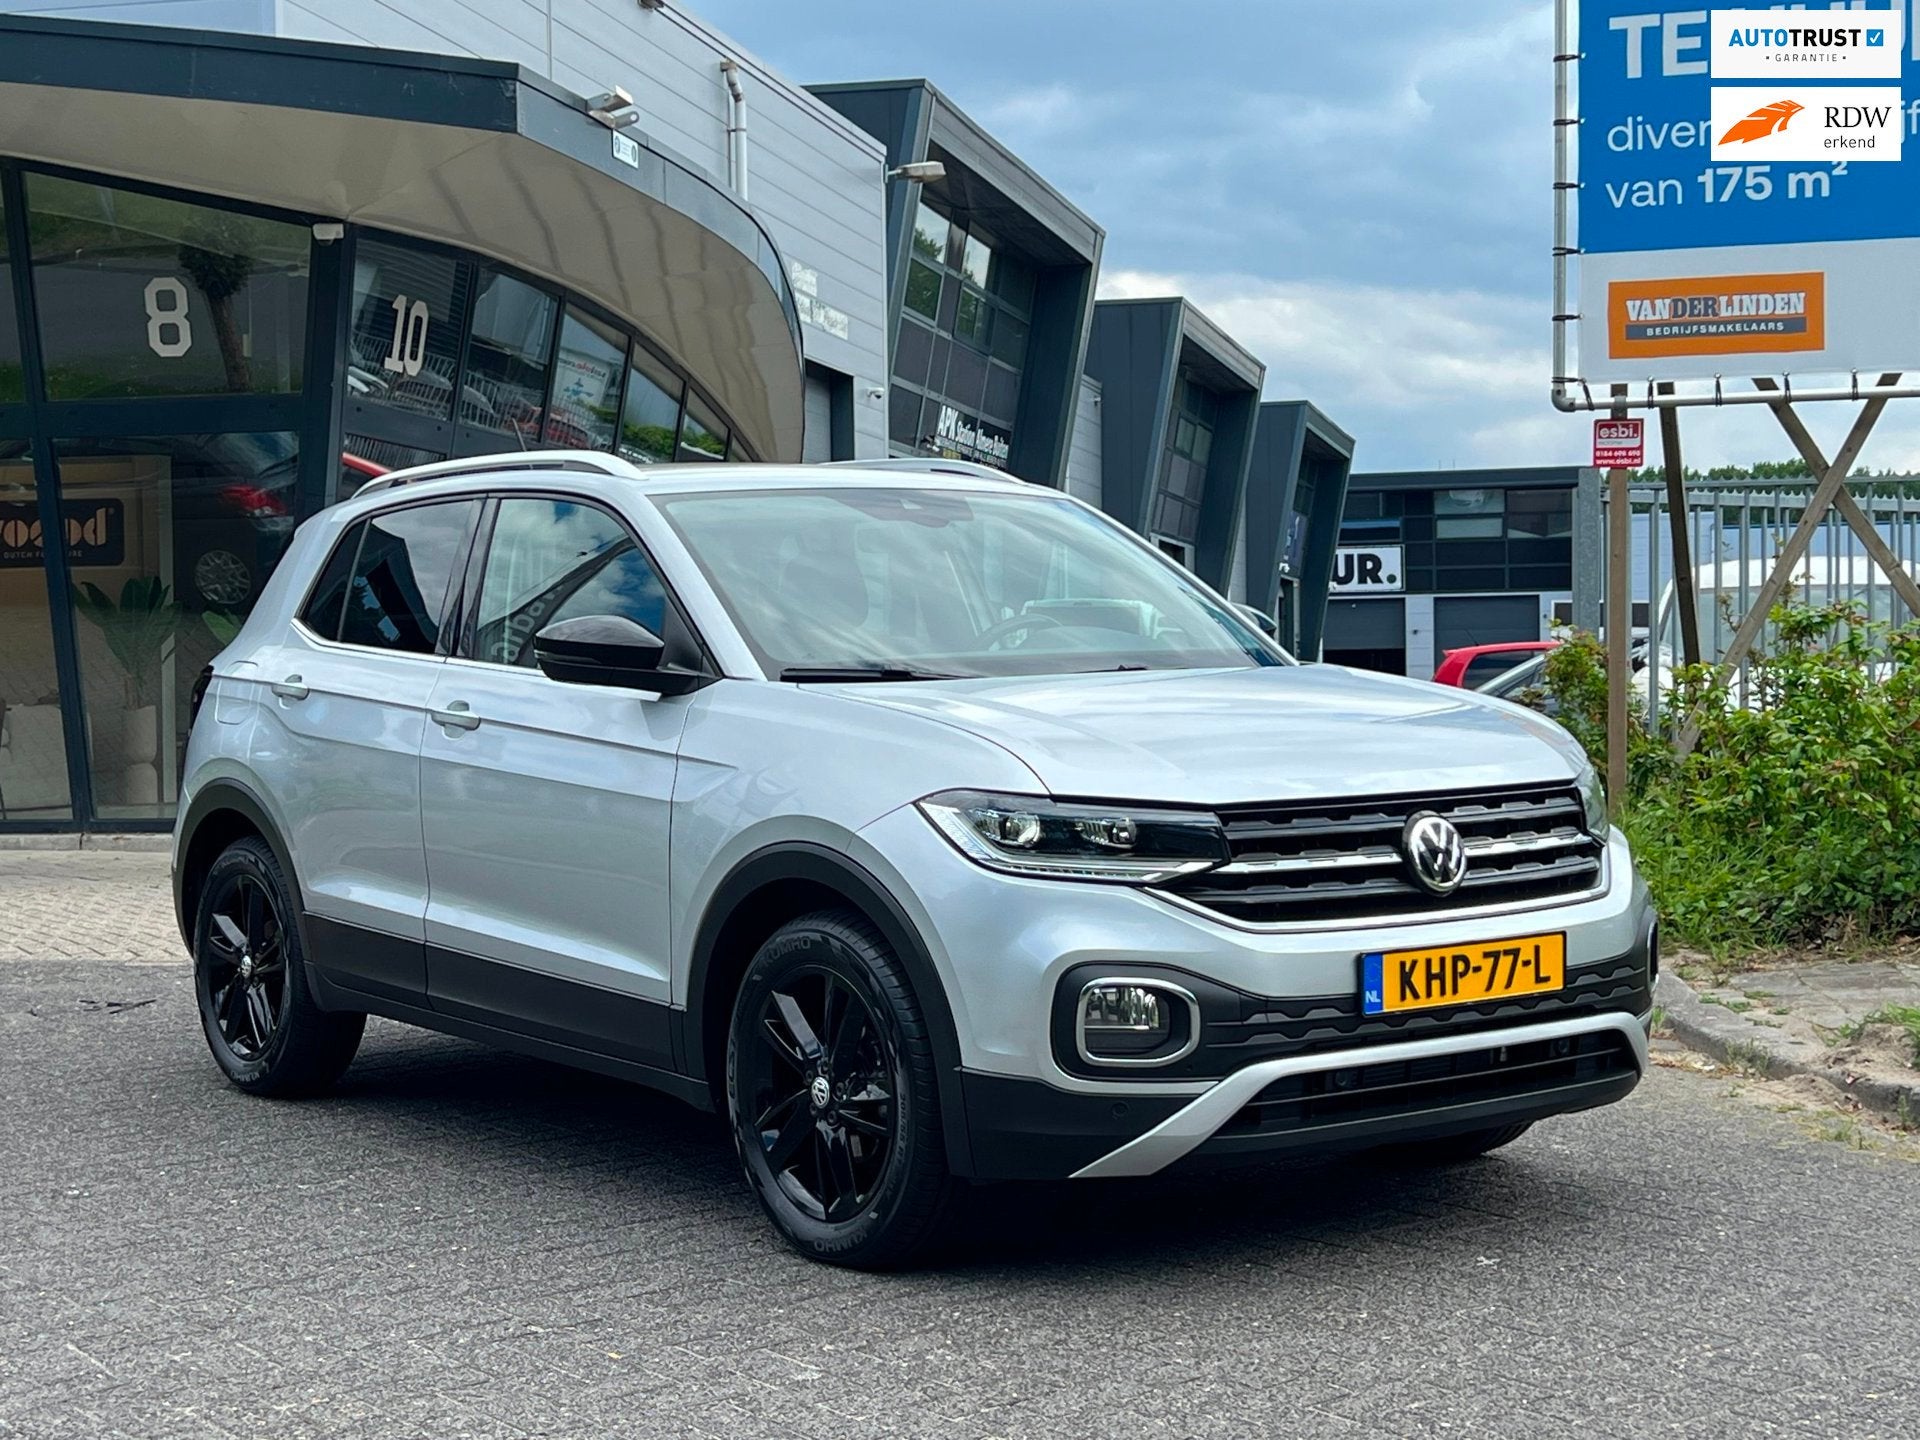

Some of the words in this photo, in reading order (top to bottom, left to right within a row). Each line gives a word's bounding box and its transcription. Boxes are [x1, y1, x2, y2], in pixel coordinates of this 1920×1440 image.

[1609, 10, 1708, 79] TE
[1605, 177, 1683, 208] van
[1697, 165, 1773, 204] 175
[143, 276, 193, 358] 8
[384, 294, 430, 377] 10
[1646, 321, 1785, 337] BEDRIJFSMAKELAARS
[938, 405, 958, 440] APK
[1365, 990, 1381, 1004] NL
[1399, 944, 1552, 1003] KHP-77-L
